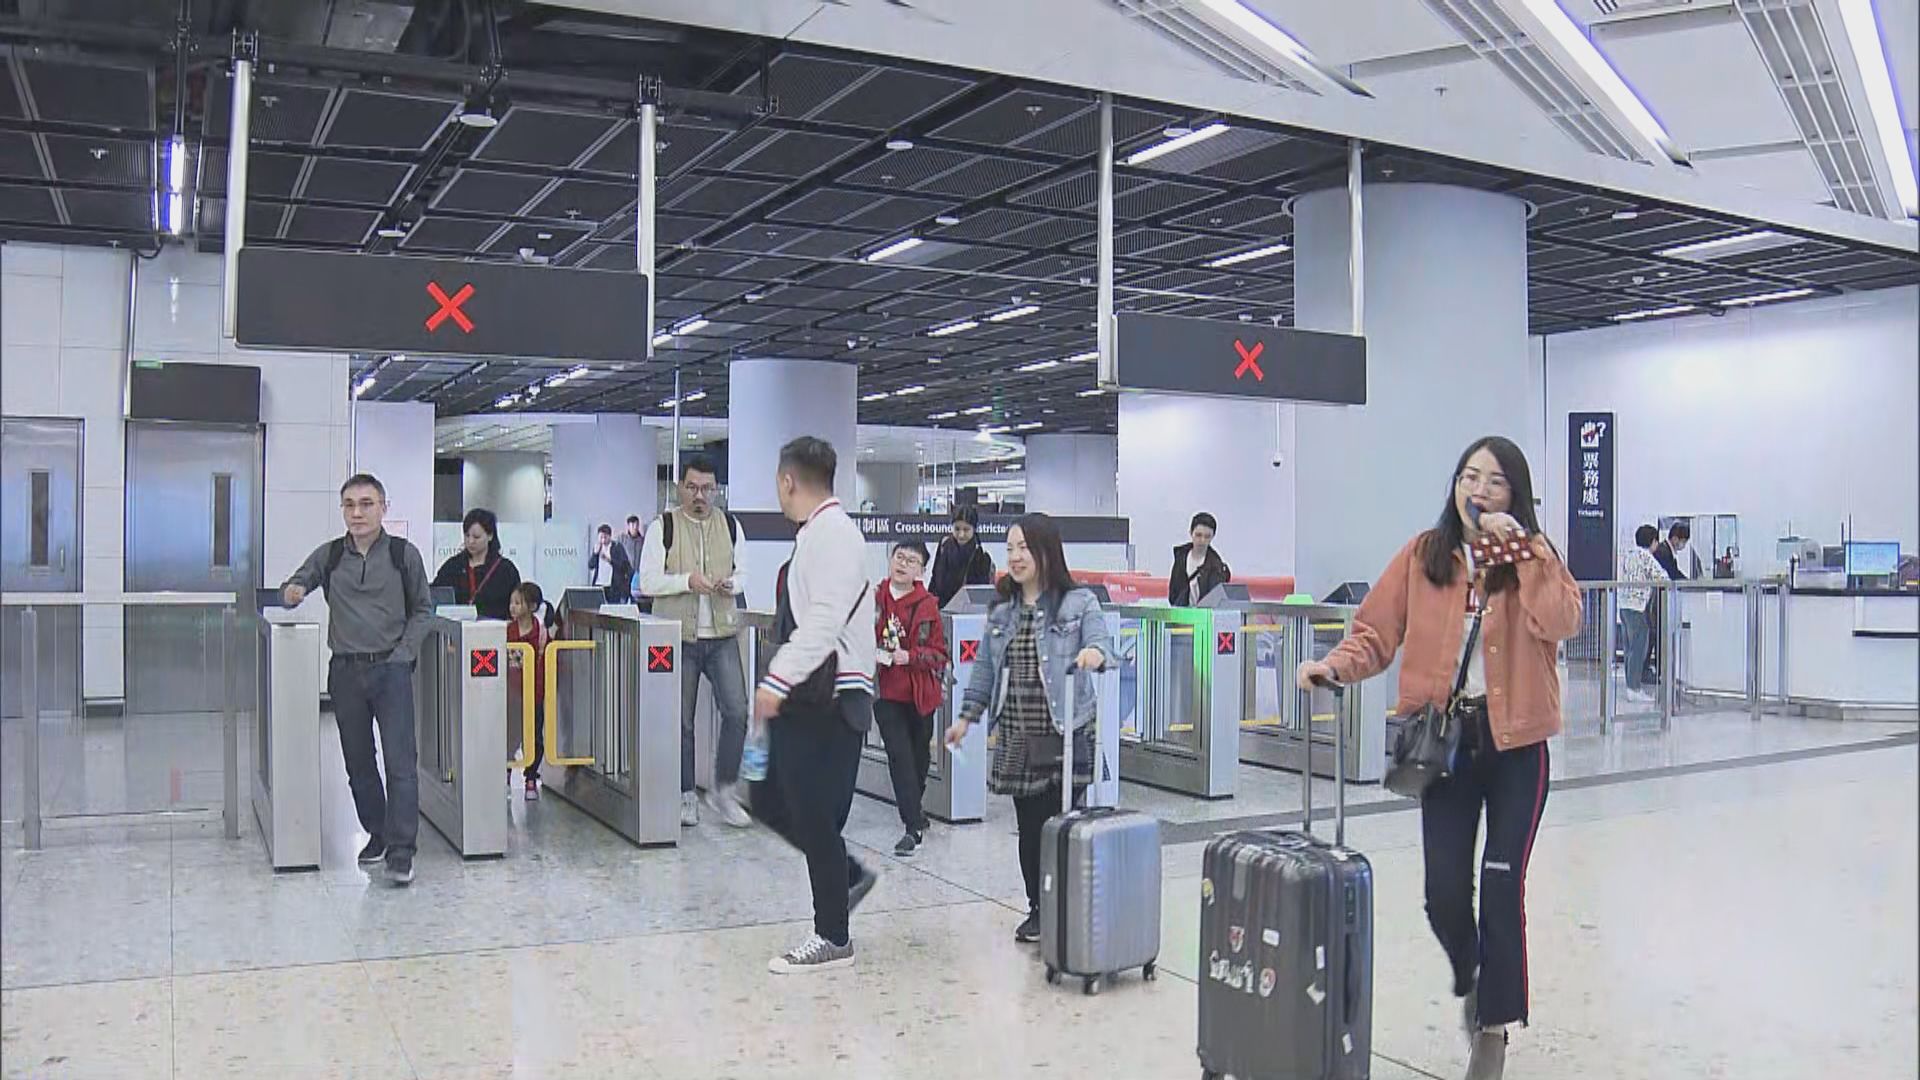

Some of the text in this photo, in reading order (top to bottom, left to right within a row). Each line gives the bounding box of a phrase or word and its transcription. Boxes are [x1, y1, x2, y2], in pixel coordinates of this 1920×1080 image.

[1582, 451, 1599, 505] 票務處
[895, 521, 953, 534] Cross-bound
[543, 547, 578, 557] CUSTOMS
